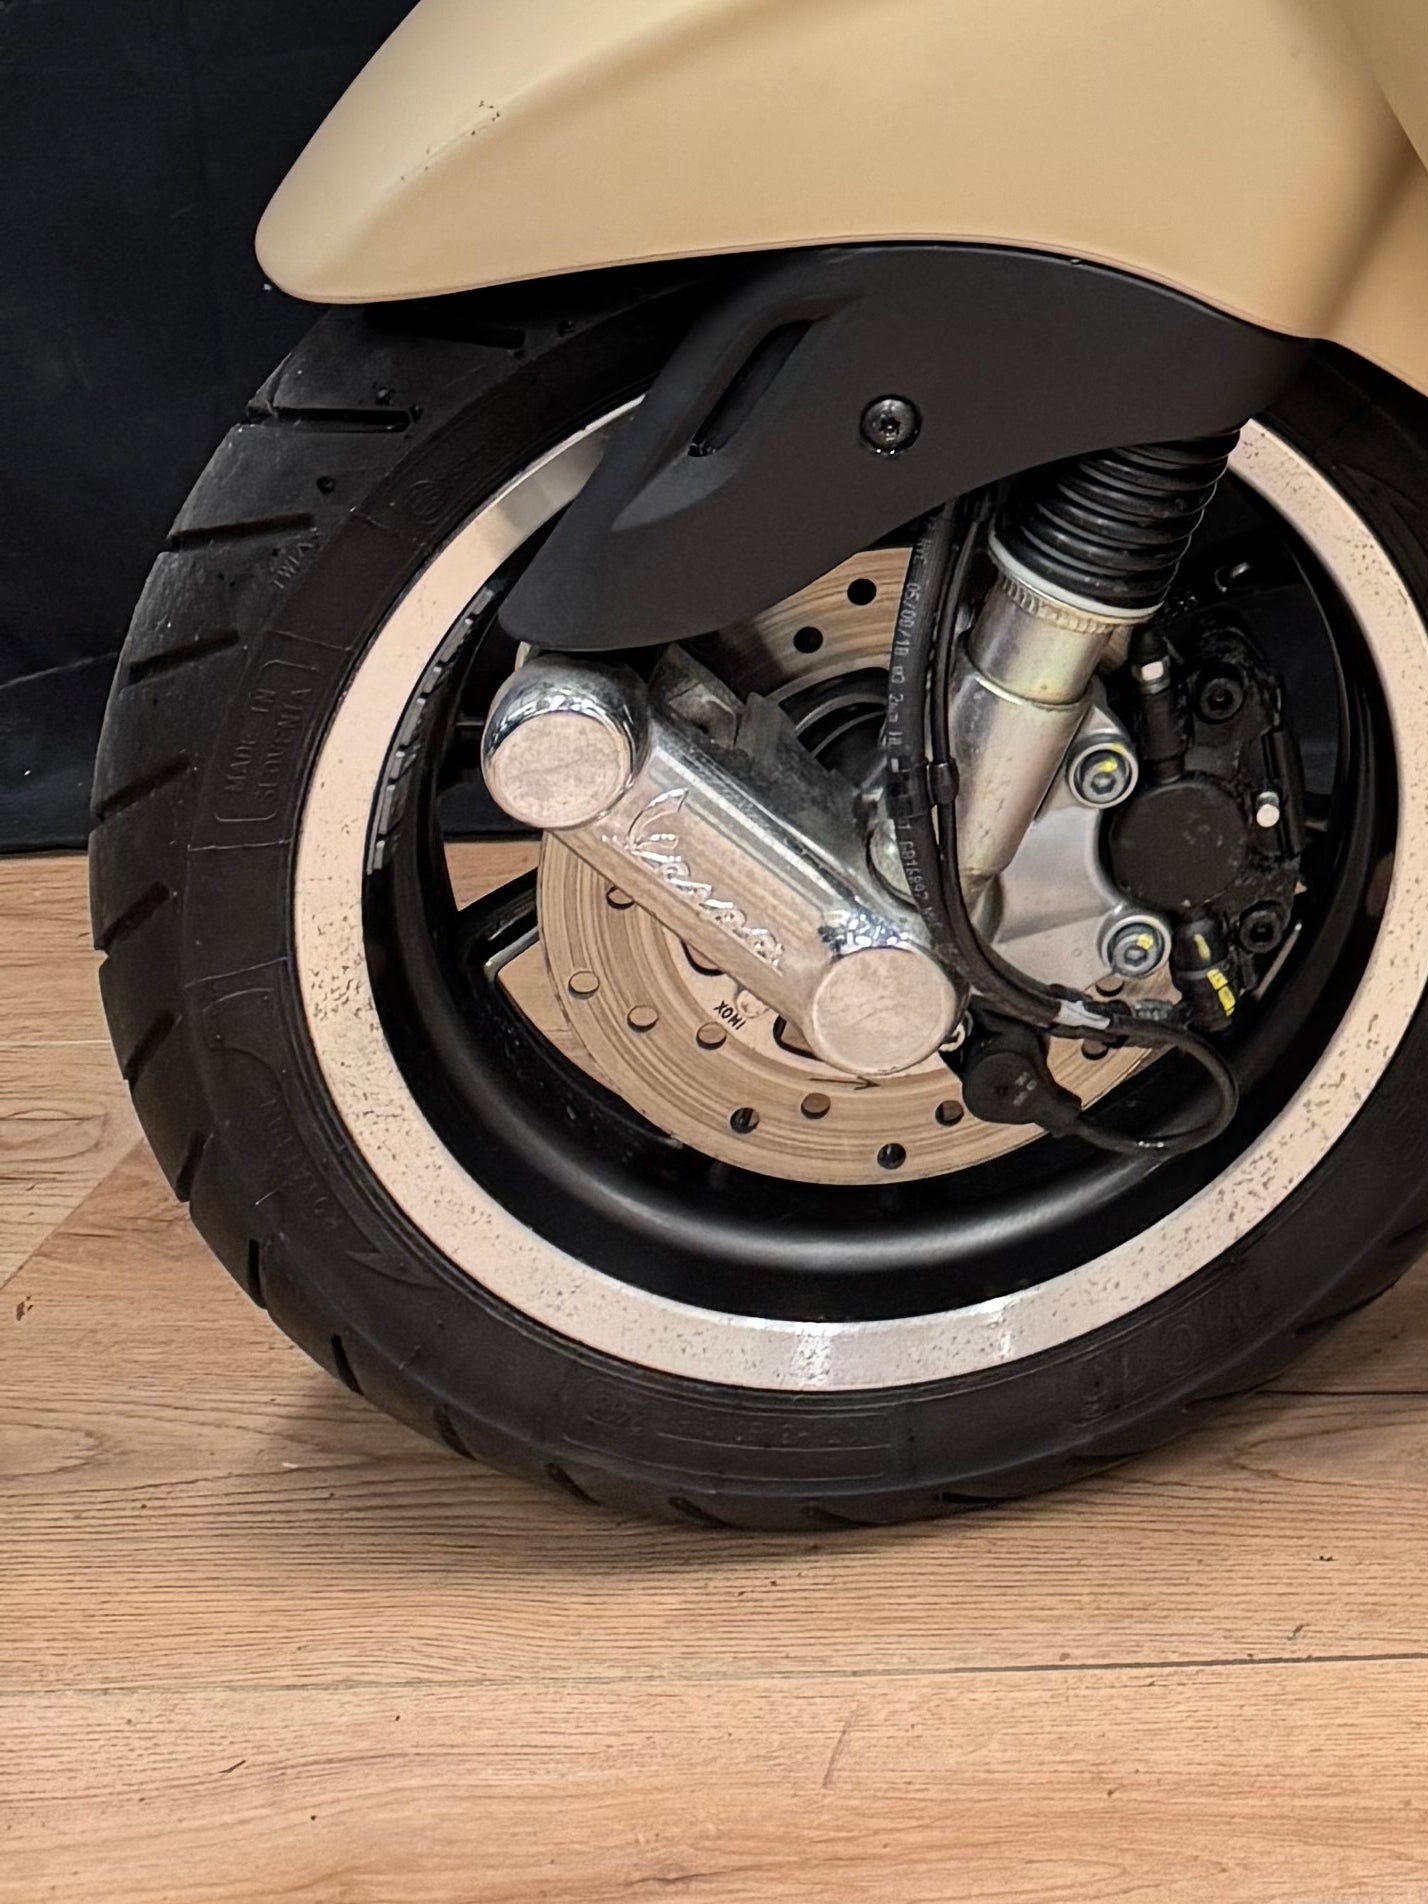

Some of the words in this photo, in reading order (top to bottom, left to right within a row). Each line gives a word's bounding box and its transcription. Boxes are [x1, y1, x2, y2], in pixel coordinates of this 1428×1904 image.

[247, 687, 278, 713] IN
[601, 789, 785, 974] Vespa
[713, 1000, 746, 1030] INOX
